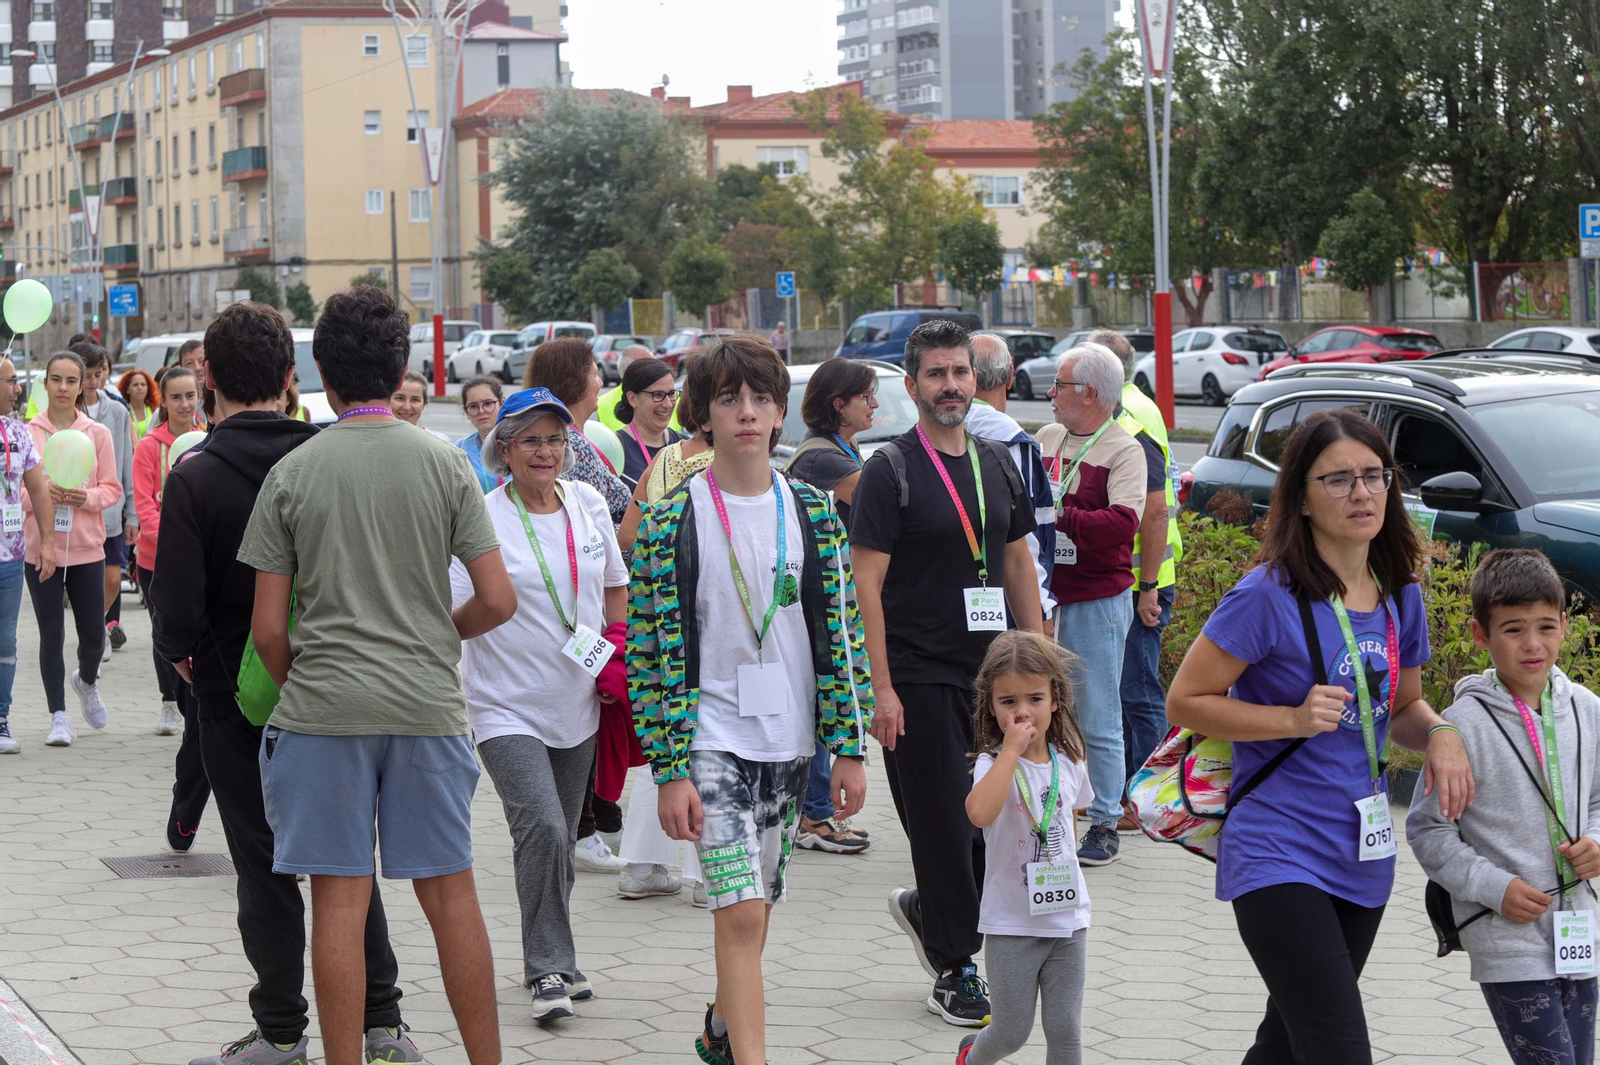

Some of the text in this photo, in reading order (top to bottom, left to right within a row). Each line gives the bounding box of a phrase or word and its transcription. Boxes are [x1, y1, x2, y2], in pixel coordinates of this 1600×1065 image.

[1585, 209, 1600, 235] P
[1054, 548, 1075, 557] 929
[733, 569, 749, 601] ASPANAEX
[970, 611, 1004, 621] 0824
[584, 639, 607, 668] 0766
[1351, 652, 1366, 689] ASPANAEX
[1014, 767, 1030, 798] ASPANAEX
[1550, 763, 1562, 801] ASPANAEX
[1365, 827, 1391, 847] 0767
[1035, 864, 1070, 873] ASPANAEX
[1046, 872, 1071, 882] Plena
[1047, 879, 1071, 887] inclusión
[1033, 888, 1076, 904] 0830
[1570, 926, 1589, 934] Plena
[1559, 944, 1592, 961] 0828
